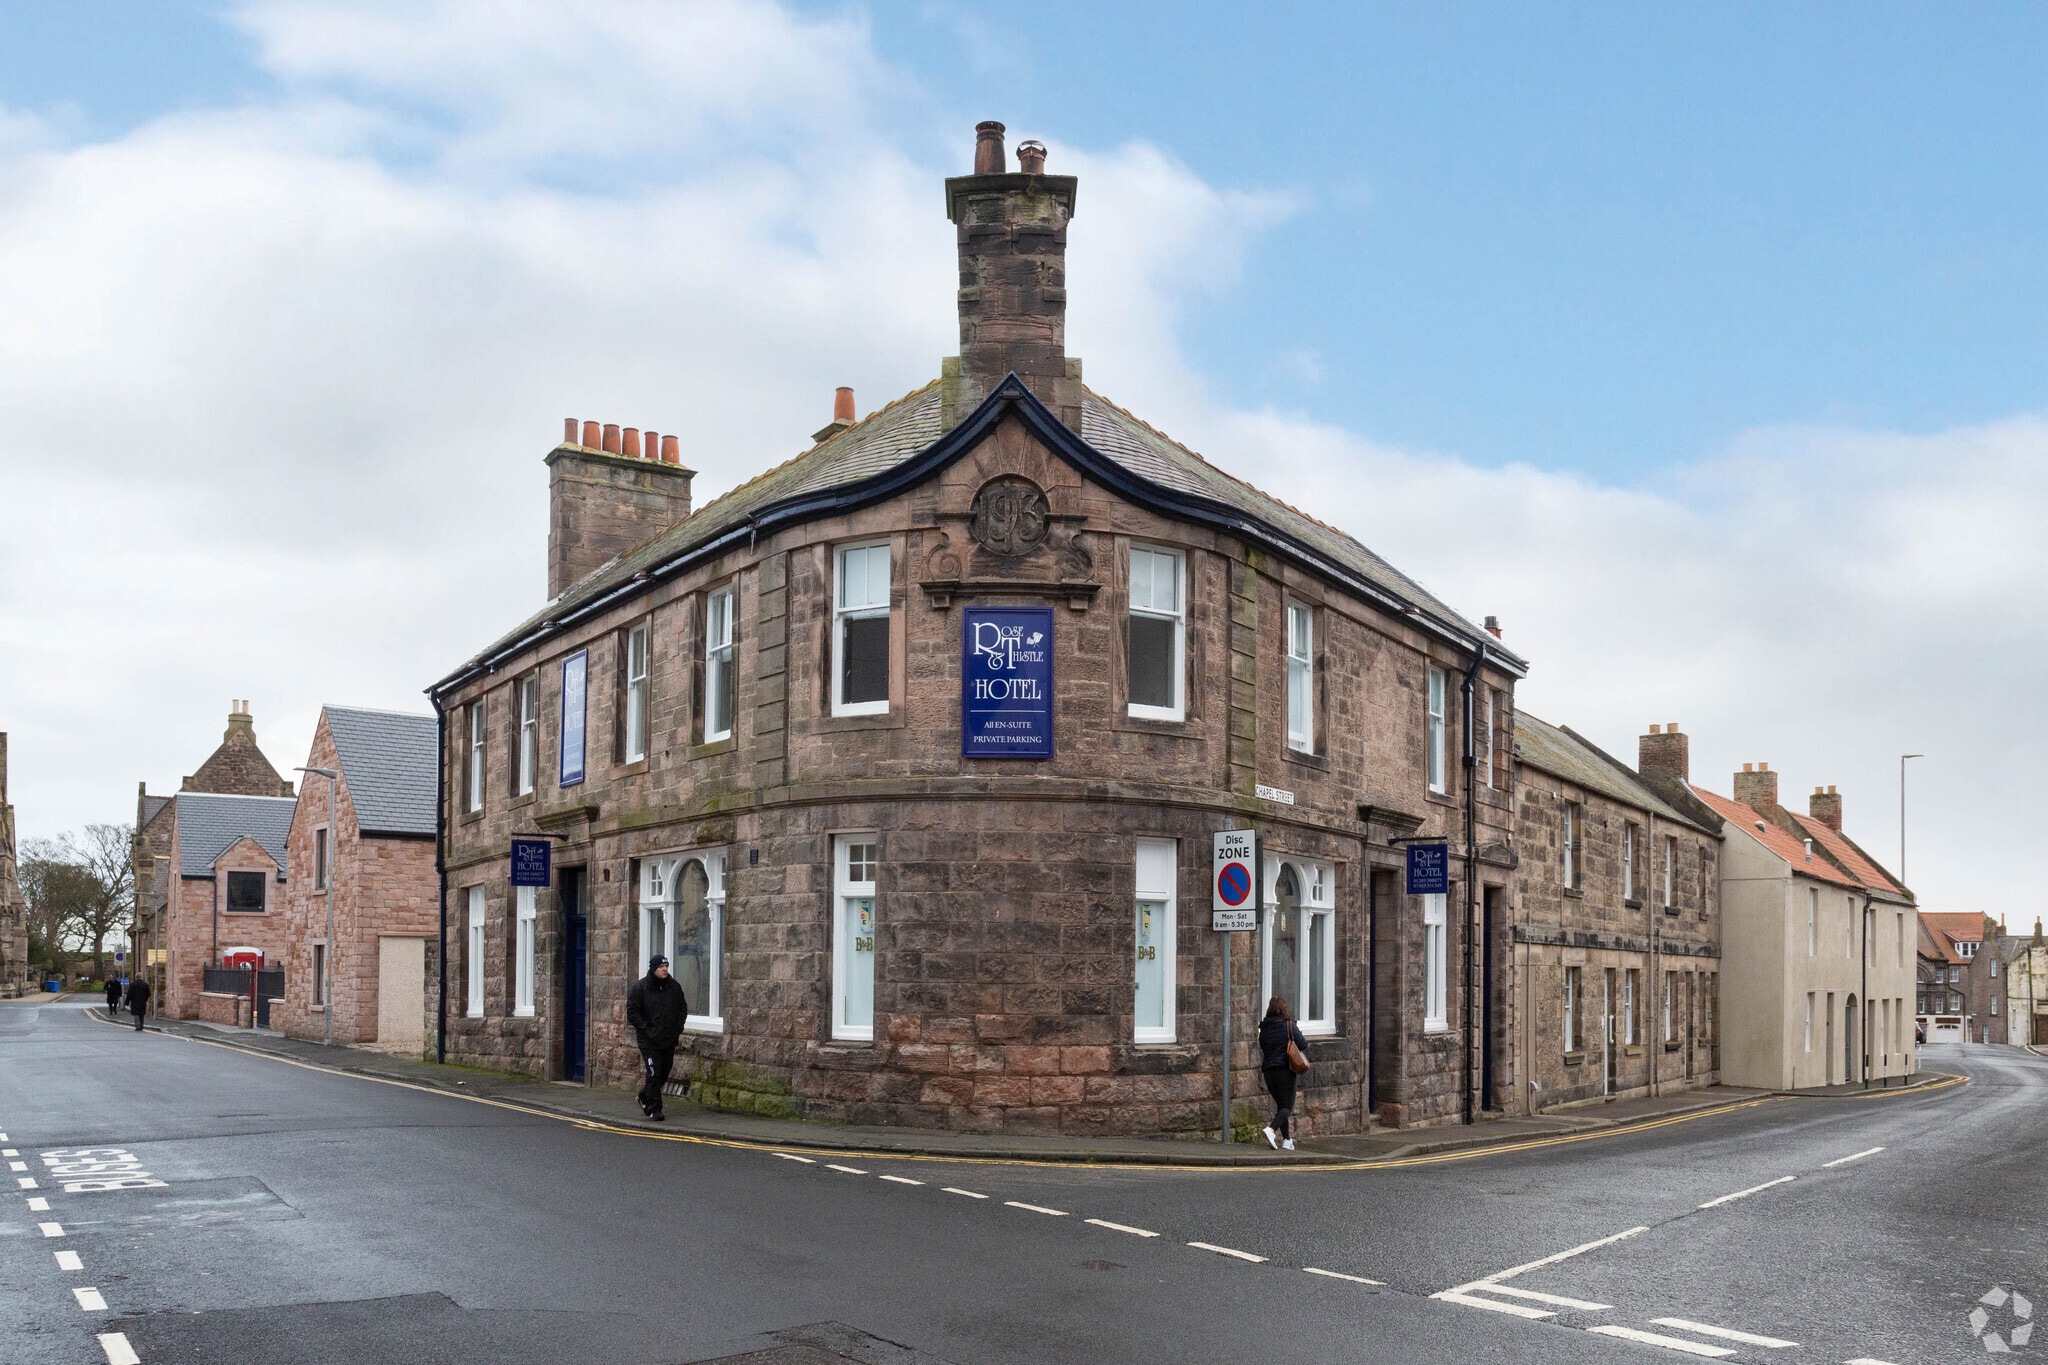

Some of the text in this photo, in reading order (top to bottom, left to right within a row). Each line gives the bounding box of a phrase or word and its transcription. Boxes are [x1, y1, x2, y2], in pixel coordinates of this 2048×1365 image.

[988, 651, 1005, 670] &
[975, 678, 1042, 700] HOTEL
[995, 721, 1032, 729] EN-SUITE
[973, 735, 1042, 744] PRIVATE PARKING
[1256, 785, 1293, 803] CHAPEL STREET
[1225, 835, 1243, 844] Disc
[1218, 846, 1250, 859] ZONE
[517, 861, 545, 871] HOTEL
[1413, 867, 1443, 878] HOTEL
[855, 936, 873, 952] B&B
[1138, 945, 1155, 960] B&B
[40, 1149, 170, 1192] BUSES
